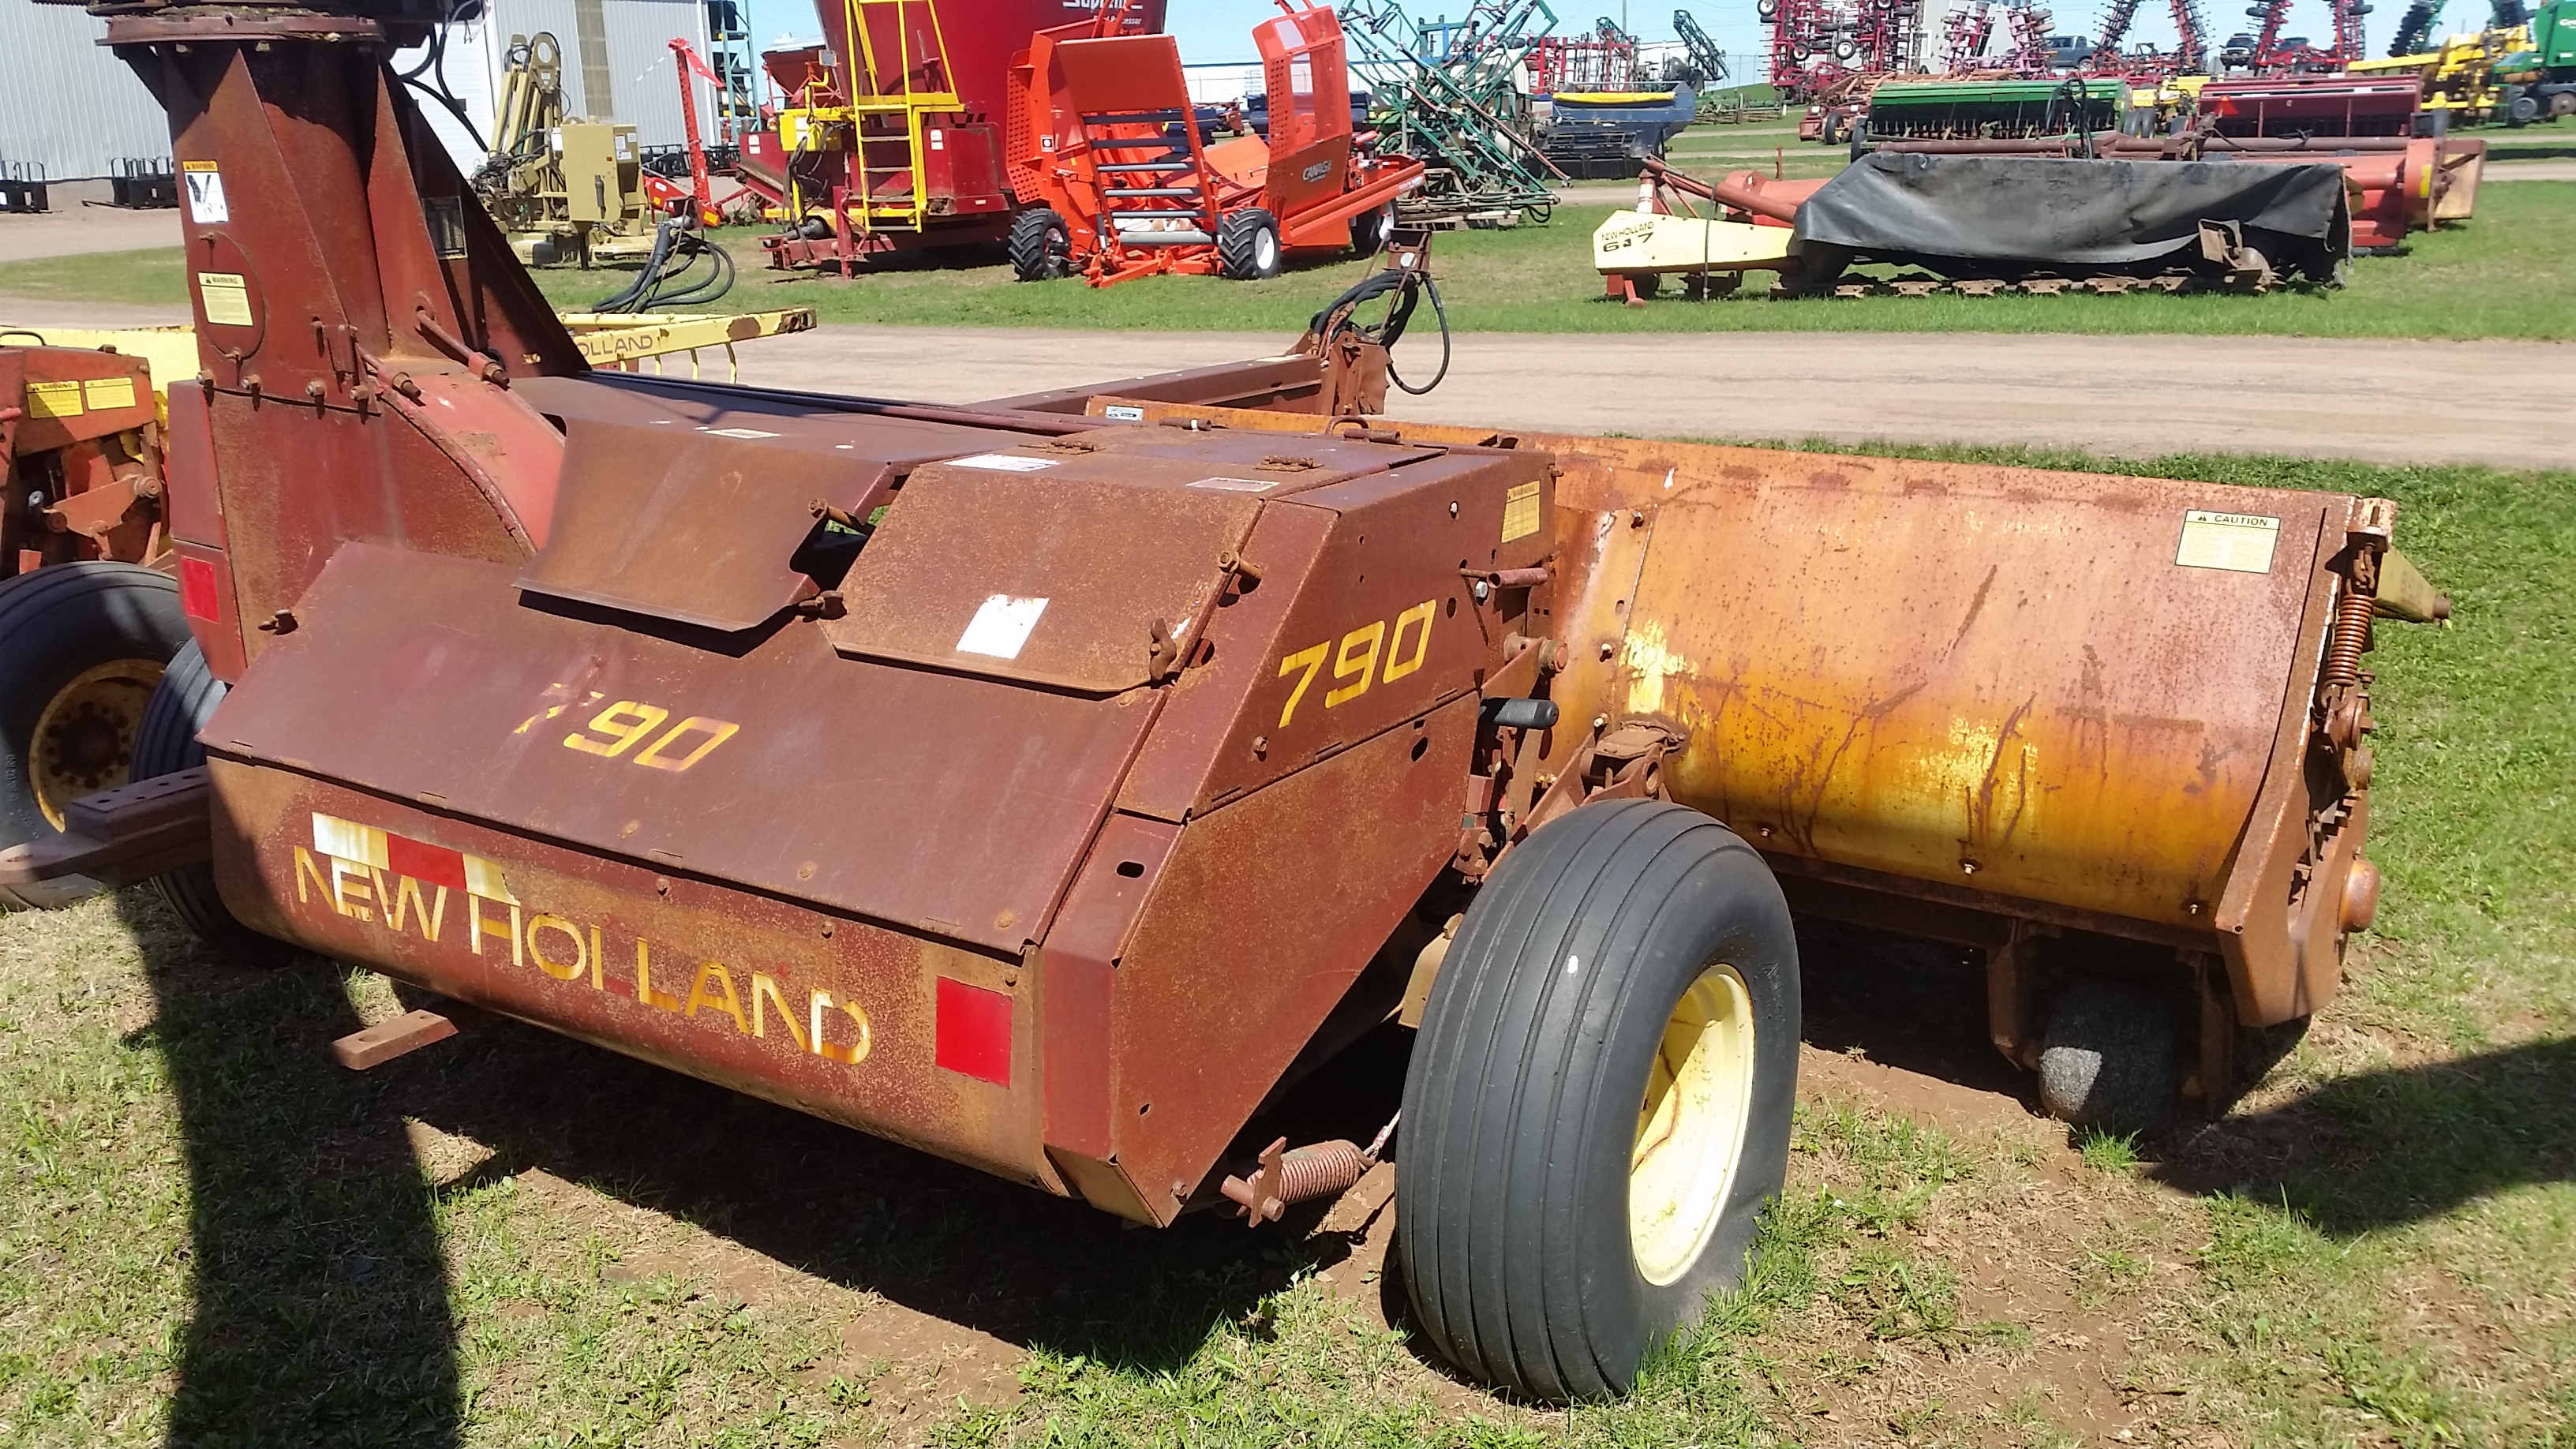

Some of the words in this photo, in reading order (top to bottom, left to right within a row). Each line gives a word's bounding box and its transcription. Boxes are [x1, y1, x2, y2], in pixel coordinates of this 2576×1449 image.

[1601, 230, 1618, 242] NEW
[1619, 221, 1654, 237] HOLLAND
[576, 335, 653, 357] OLLAND
[2214, 515, 2268, 526] CAUTION
[1278, 598, 1437, 729] 790
[294, 844, 447, 942] NEW
[468, 891, 873, 1065] HOLLAND
